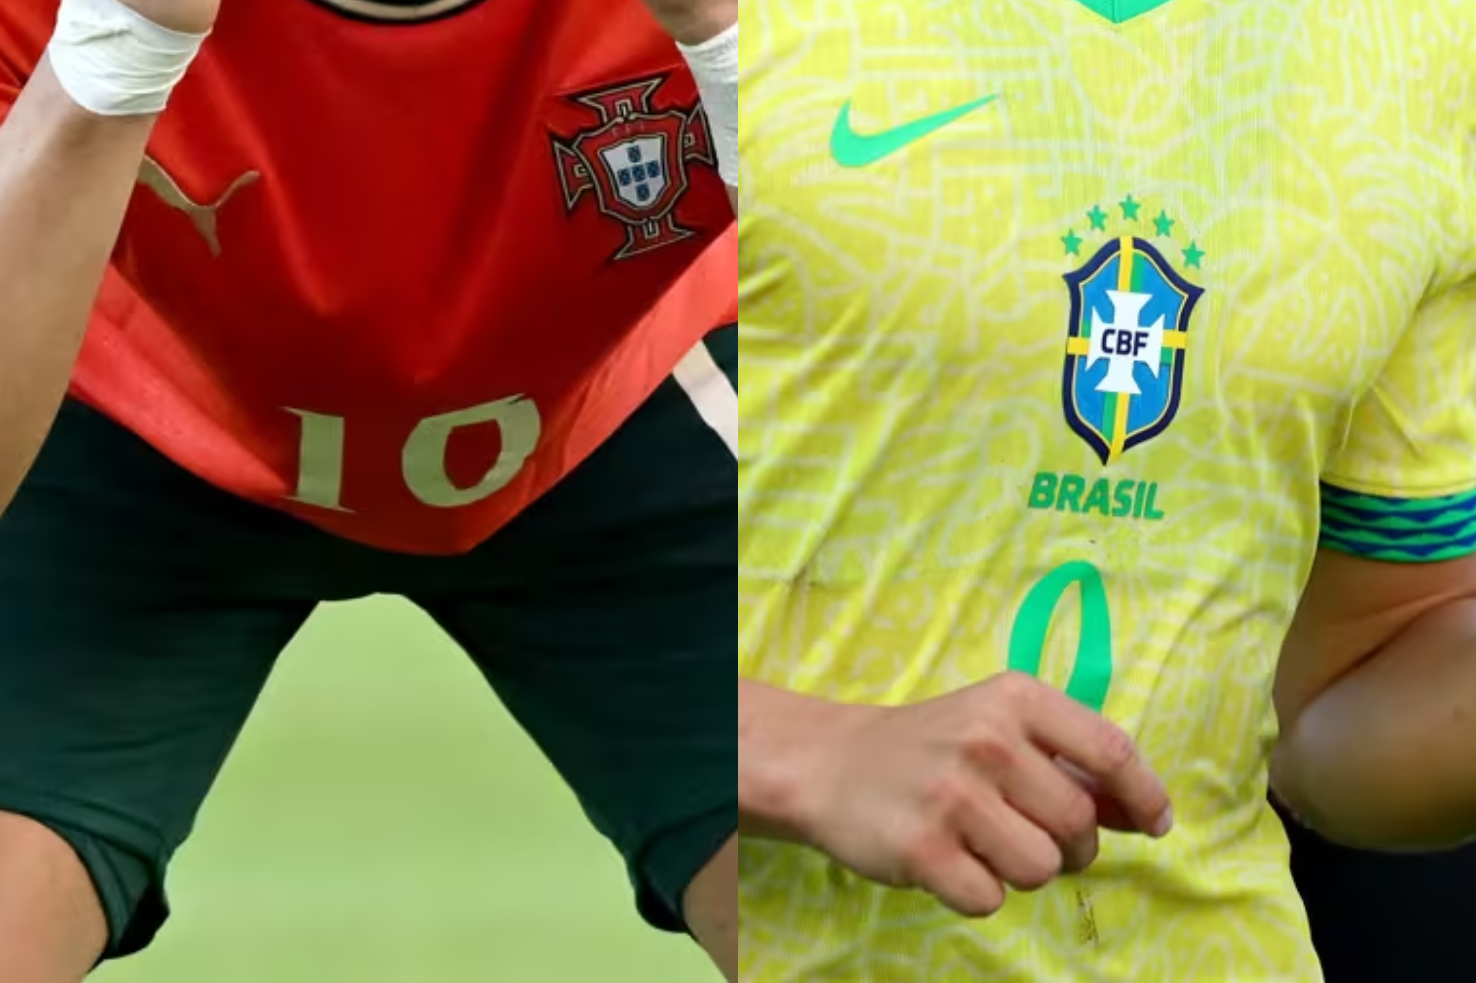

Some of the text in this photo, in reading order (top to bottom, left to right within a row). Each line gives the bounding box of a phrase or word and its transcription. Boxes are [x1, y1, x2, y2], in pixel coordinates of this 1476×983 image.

[1101, 328, 1149, 358] CBF
[280, 392, 542, 514] 10
[1028, 471, 1165, 520] BRASIL
